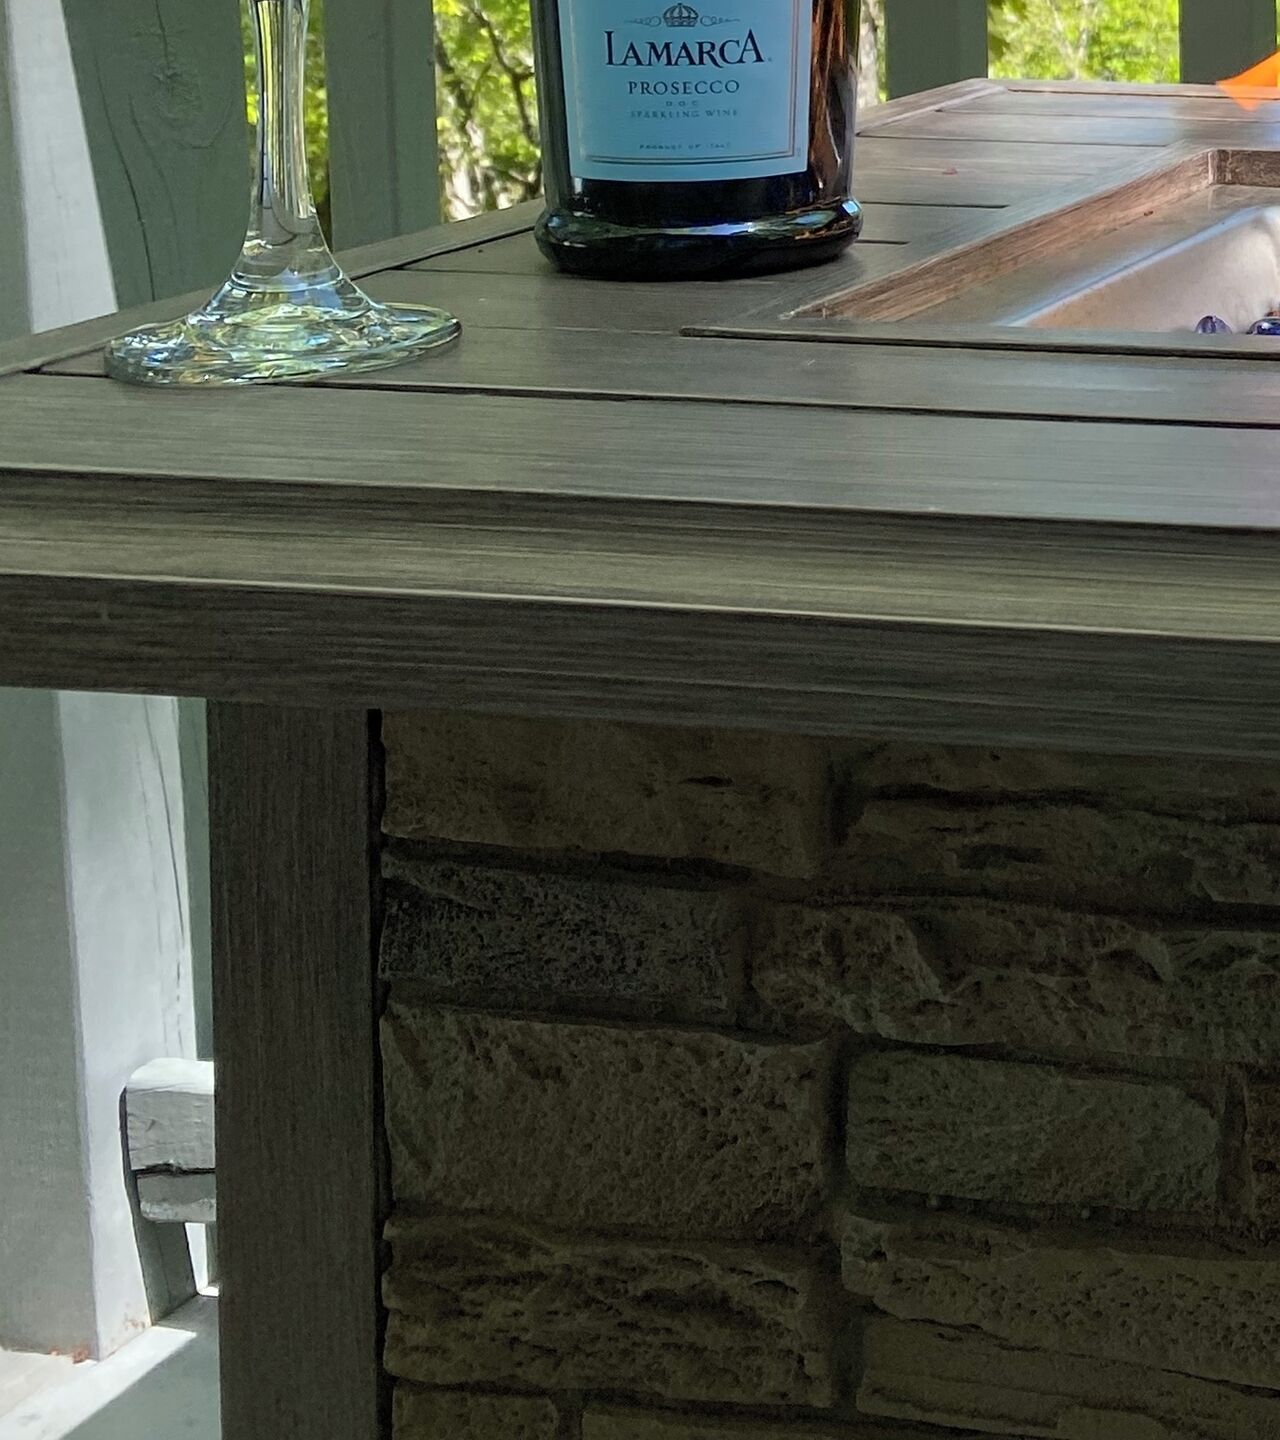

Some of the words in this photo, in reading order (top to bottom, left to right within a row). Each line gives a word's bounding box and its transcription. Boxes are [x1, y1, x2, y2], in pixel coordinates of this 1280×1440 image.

[604, 29, 765, 68] LAMARCA
[628, 79, 741, 95] PROSECCO
[705, 109, 738, 117] WINE
